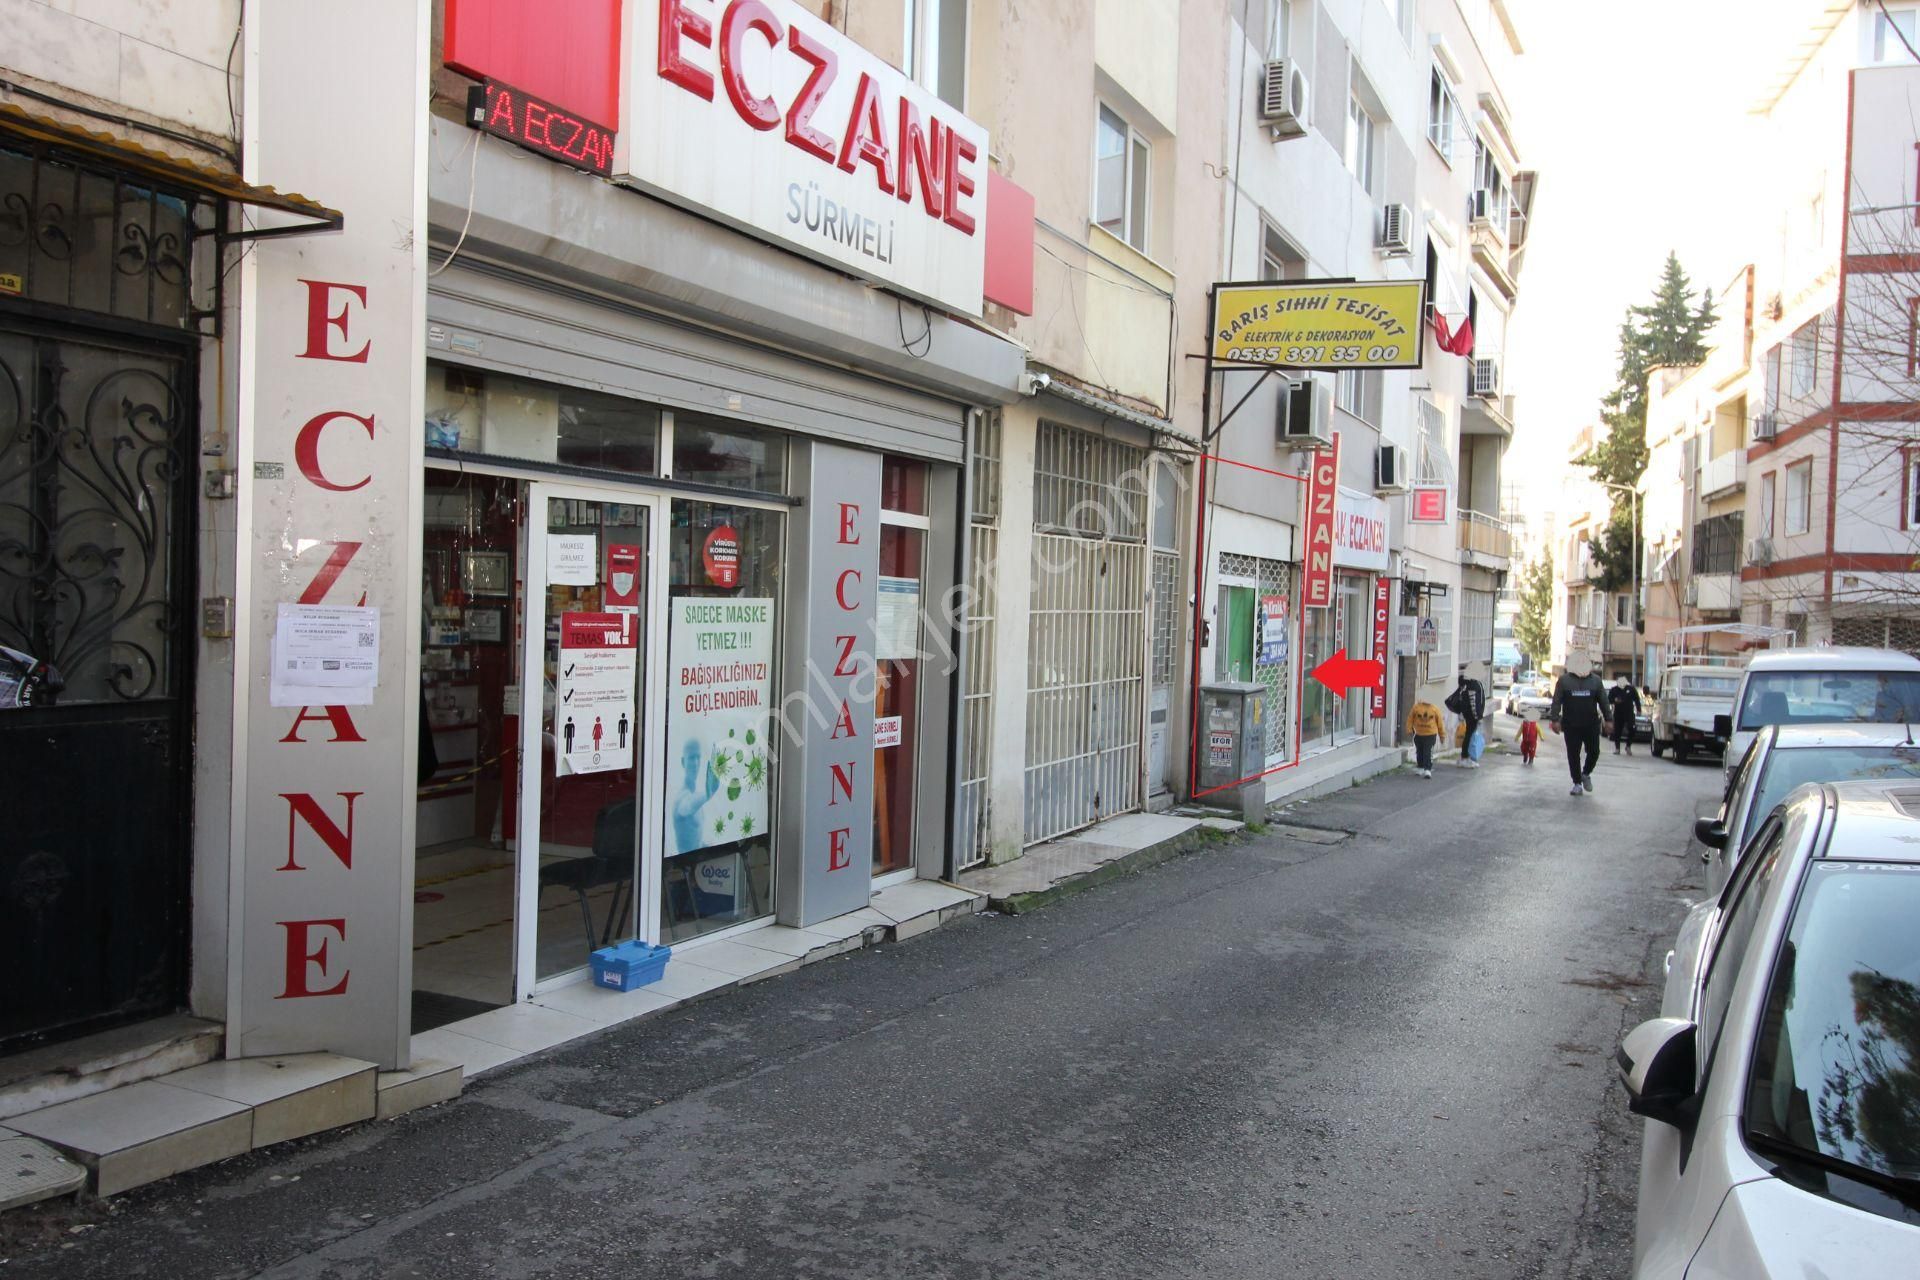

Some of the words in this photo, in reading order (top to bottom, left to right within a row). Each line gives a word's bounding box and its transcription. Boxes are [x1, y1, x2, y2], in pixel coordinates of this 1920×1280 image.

[486, 85, 515, 133] A
[658, 0, 977, 237] ECZANE
[786, 181, 895, 265] SÜRMELİ
[1219, 303, 1269, 343] BARIŞ
[1275, 294, 1331, 314] SIHHİ
[1335, 297, 1408, 338] TESİSAT
[1244, 328, 1293, 343] ELEKTRİK
[1305, 329, 1375, 343] DEKORASYON
[1226, 346, 1280, 363] 0535
[1285, 346, 1326, 363] 391
[1330, 346, 1362, 362] 35
[1366, 344, 1399, 361] 00
[1420, 493, 1440, 516] E
[685, 605, 722, 624] SADECE
[726, 605, 767, 623] MASKE
[570, 632, 602, 645] TEMAS
[696, 631, 737, 651] YETMEZ
[681, 660, 767, 690] BAĞIŞIKLIĞINIZI
[826, 501, 861, 873] ECZANE
[685, 685, 762, 717] GÜÇLENDİRİN.
